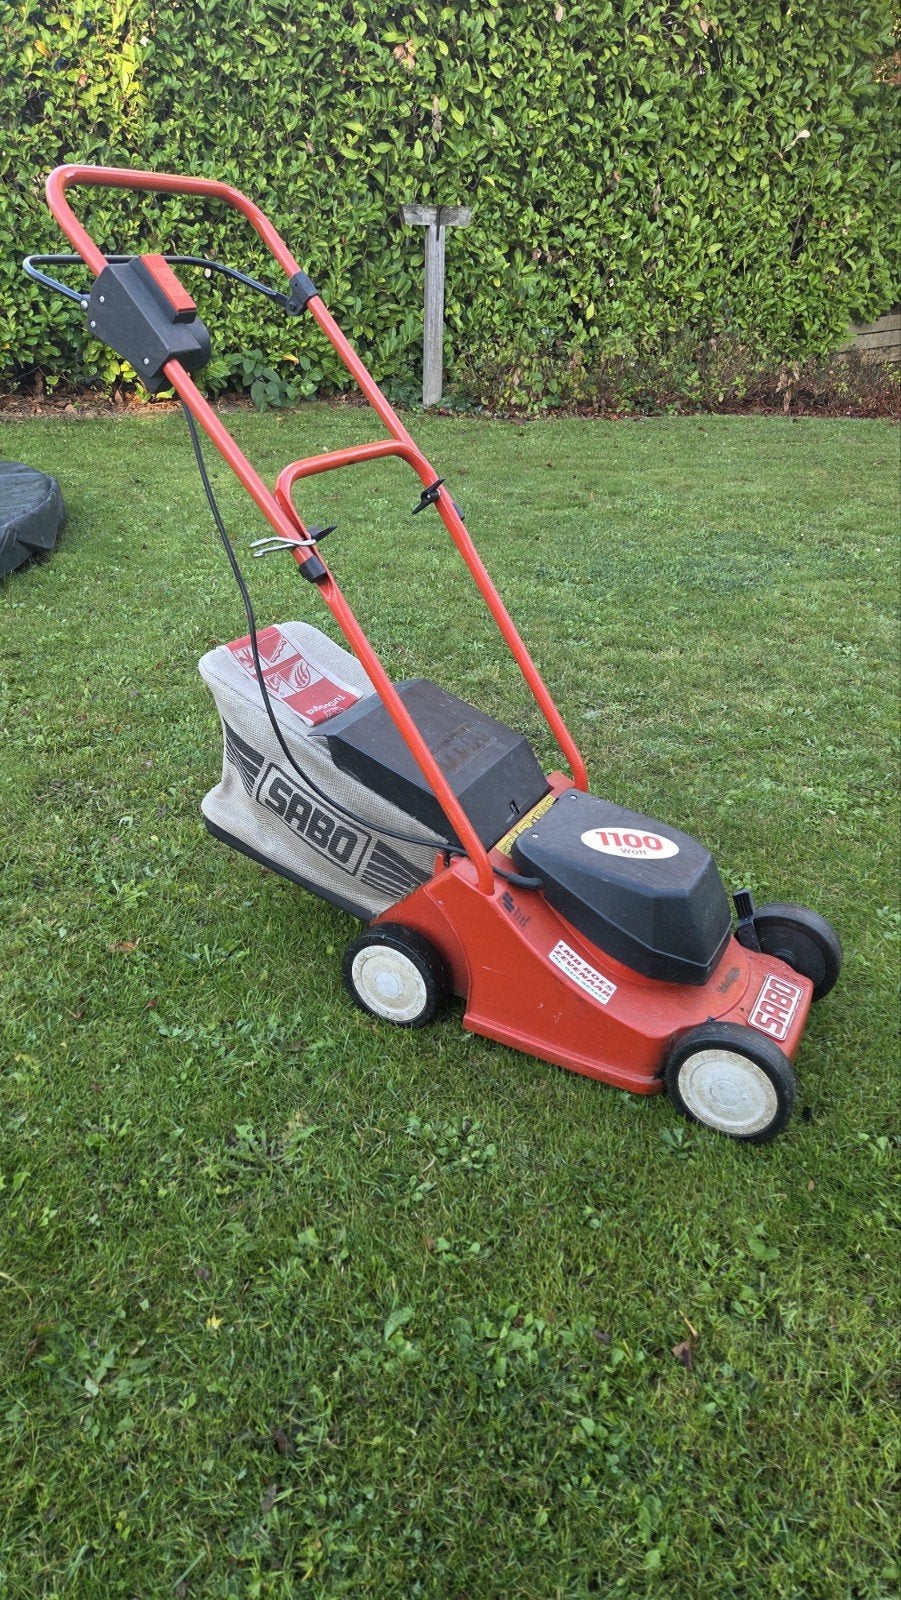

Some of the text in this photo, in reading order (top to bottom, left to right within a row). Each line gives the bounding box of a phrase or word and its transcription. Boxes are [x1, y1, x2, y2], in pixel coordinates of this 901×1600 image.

[266, 777, 358, 865] SABO
[595, 831, 663, 851] 1100
[620, 847, 648, 856] Watt
[554, 950, 611, 997] ZEVENAAR
[558, 944, 582, 966] LMB
[583, 967, 614, 992] ROES
[754, 978, 797, 1034] SABO
